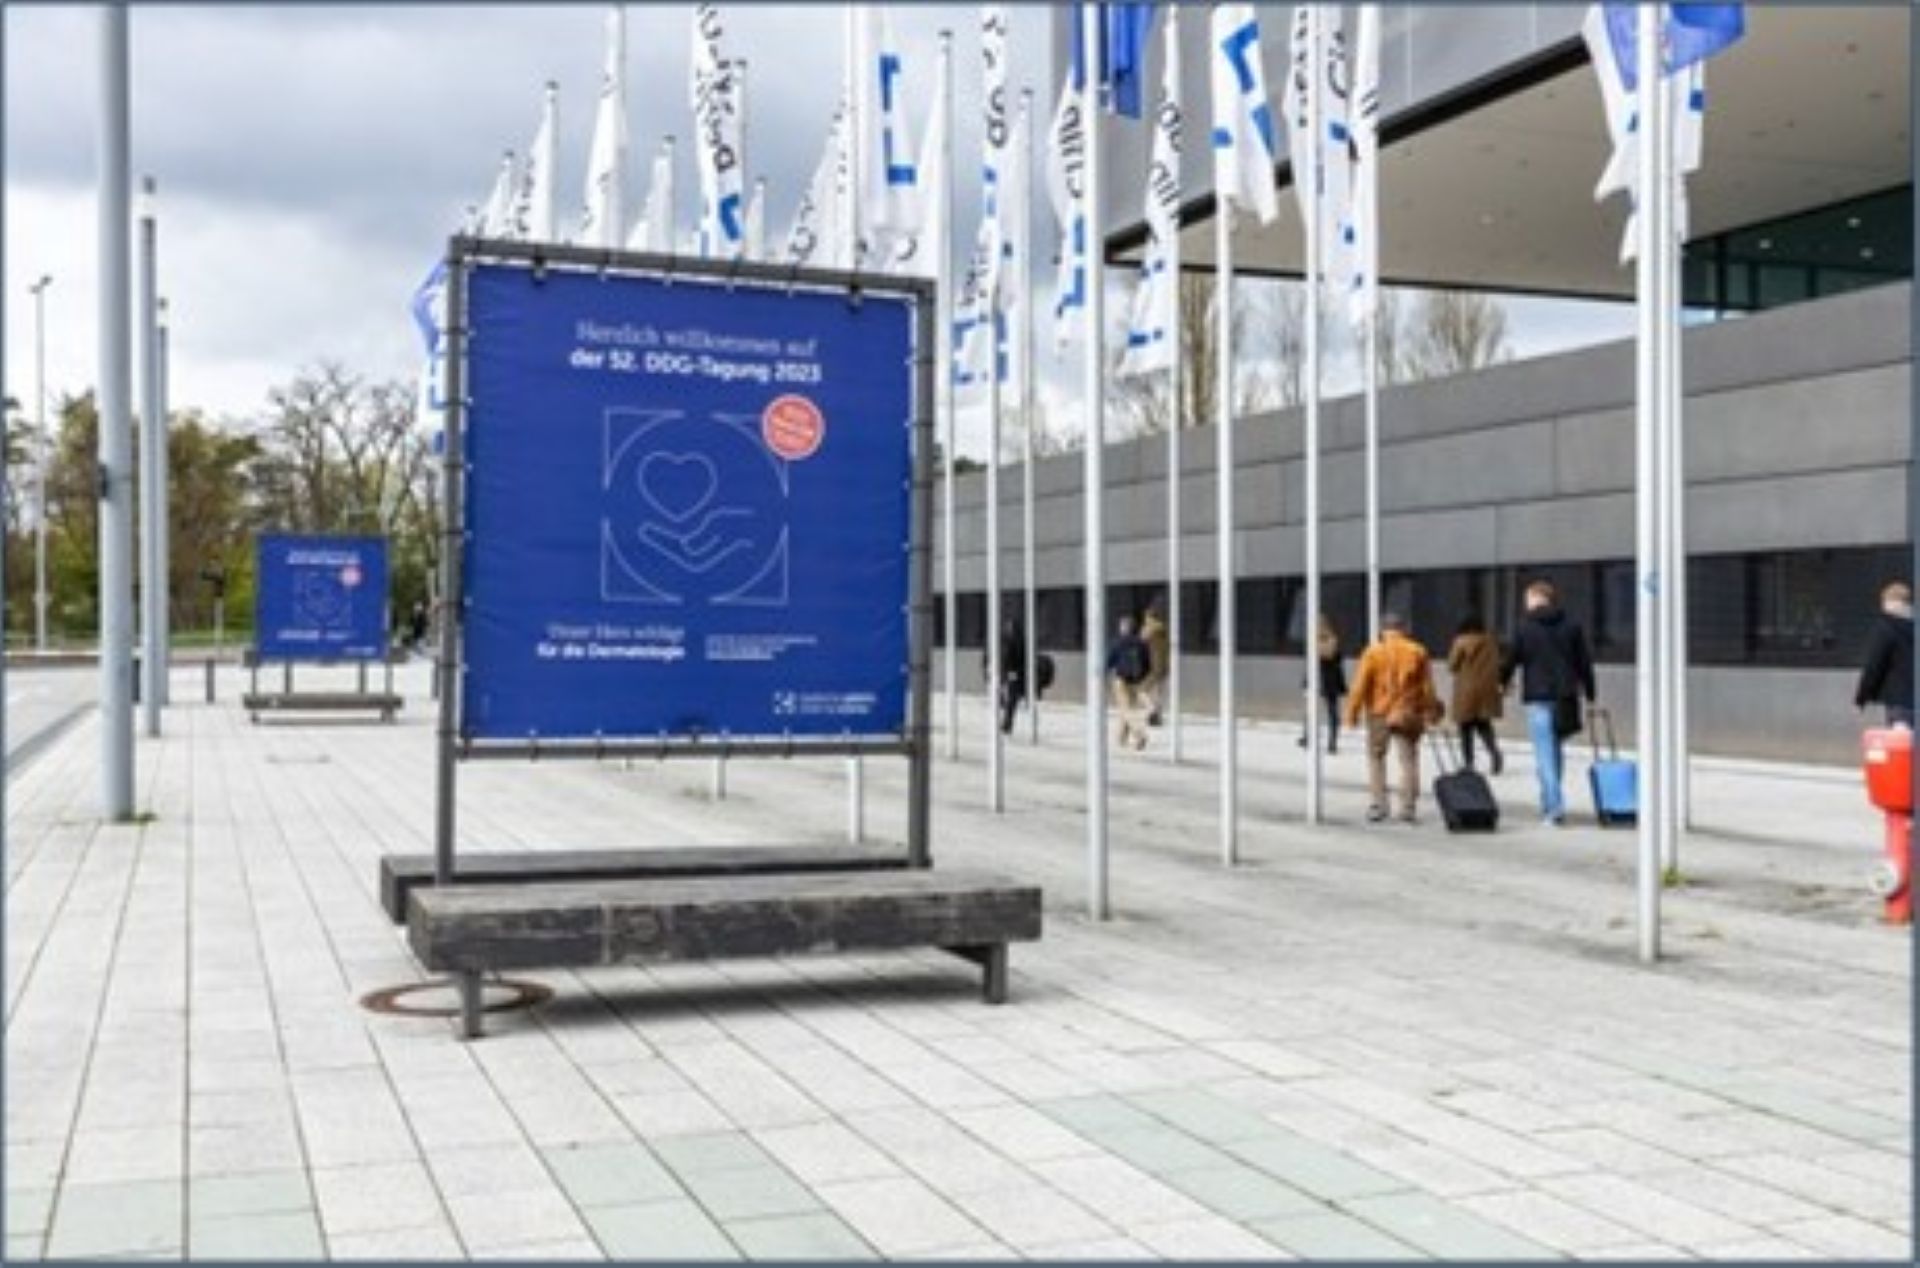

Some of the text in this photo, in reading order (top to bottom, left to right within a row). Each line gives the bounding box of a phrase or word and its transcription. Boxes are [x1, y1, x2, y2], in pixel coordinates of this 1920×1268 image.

[570, 348, 602, 369] der
[646, 351, 769, 384] DDG-Tagung
[775, 361, 822, 383] 2023
